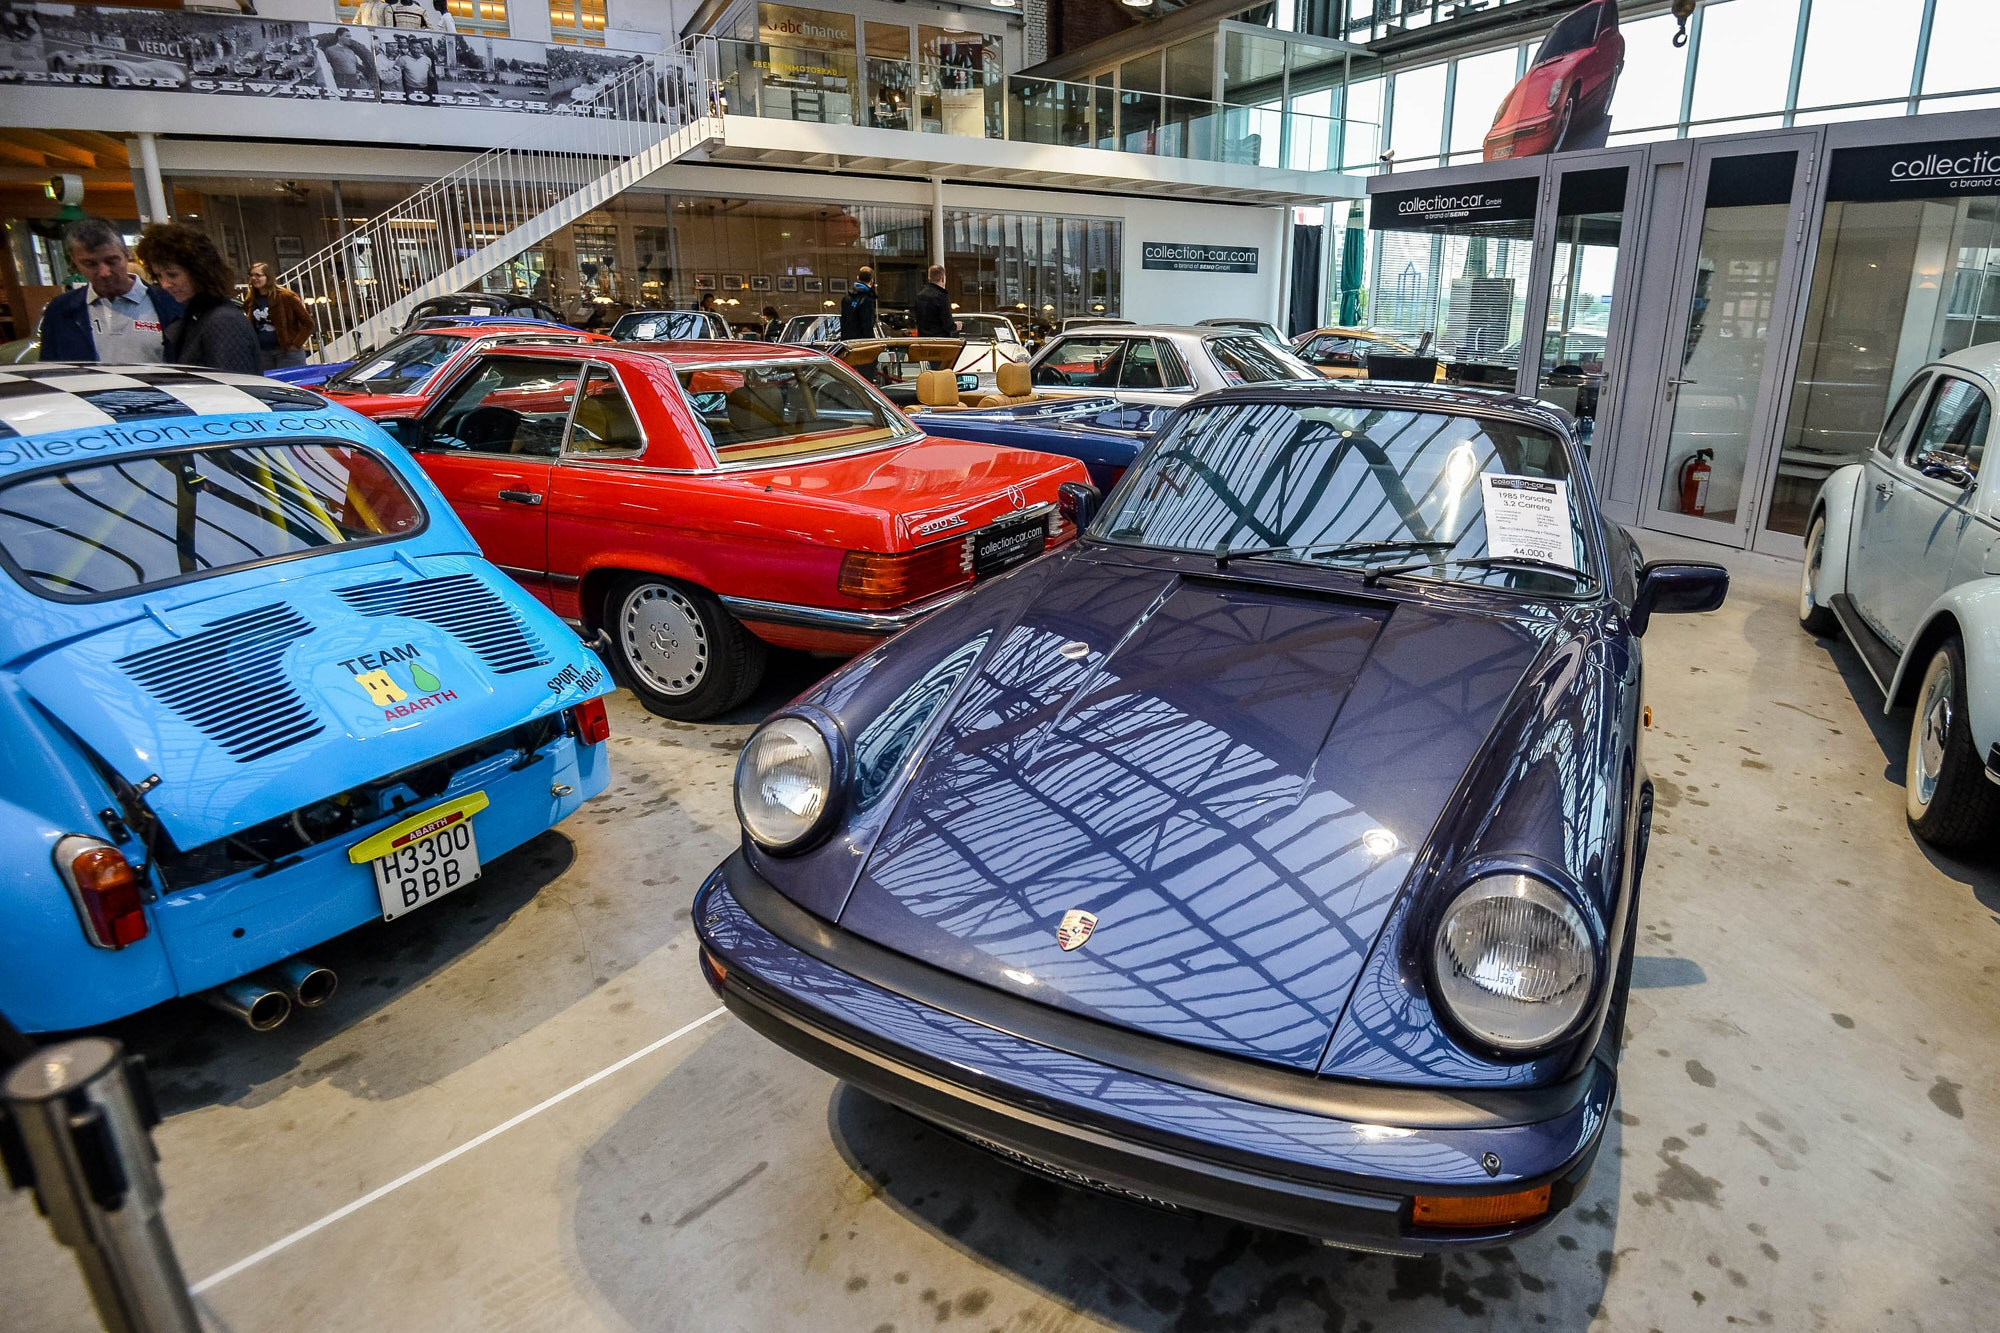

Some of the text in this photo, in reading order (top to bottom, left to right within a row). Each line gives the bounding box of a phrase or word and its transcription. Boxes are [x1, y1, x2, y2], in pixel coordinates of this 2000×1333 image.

[780, 18, 849, 41] abcfinance
[115, 75, 181, 89] ICH
[190, 80, 376, 99] GEWINNE
[381, 89, 481, 106] HÖRE
[490, 98, 549, 112] ICH
[1949, 180, 1958, 188] a
[1959, 178, 1993, 188] brand
[1398, 194, 1484, 213] collection-car
[1429, 212, 1444, 220] brand
[1145, 246, 1257, 262] collection-car.com
[1498, 492, 1553, 504] 1985 Porsche
[1518, 502, 1551, 511] Carrera
[920, 515, 968, 533] 300 SL
[980, 526, 1043, 556] collection-car.com
[1513, 548, 1554, 560] 44.000 €
[336, 643, 422, 676] TEAM
[546, 663, 581, 696] SPORT
[575, 665, 604, 694] ROCA
[384, 689, 459, 722] ABARTH
[409, 817, 448, 841] ABARTH
[381, 823, 470, 885] H3300
[400, 858, 461, 908] BBB
